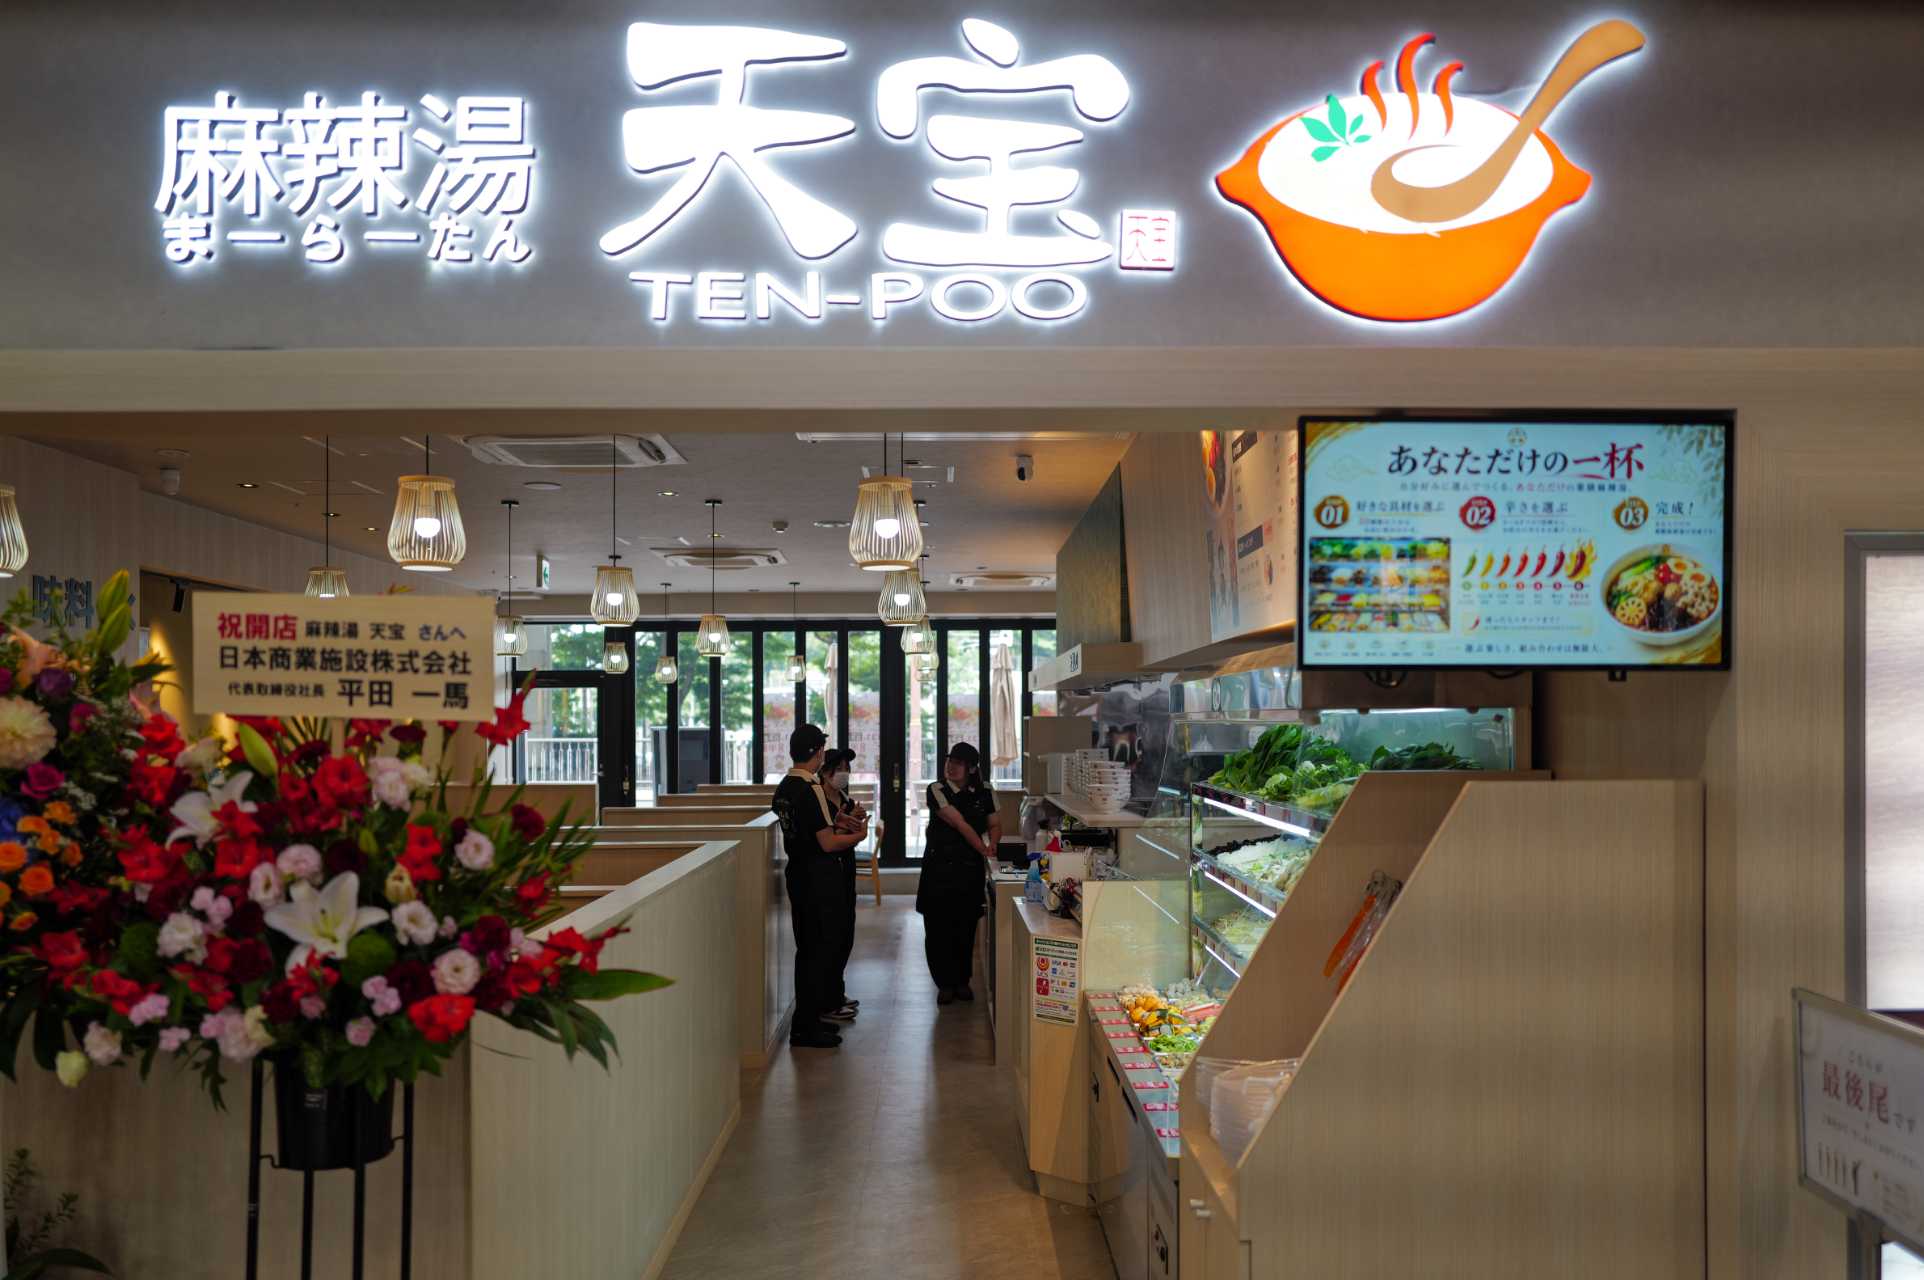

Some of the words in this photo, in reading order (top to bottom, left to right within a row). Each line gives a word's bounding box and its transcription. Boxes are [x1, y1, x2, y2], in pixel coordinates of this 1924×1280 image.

[154, 90, 536, 217] 麻辣湯
[599, 17, 1130, 268] 天宝
[161, 212, 534, 265] まーらーたん
[629, 271, 1088, 322] TEN-POO
[1387, 442, 1645, 480] あなただけの一杯
[1320, 505, 1345, 526] 01
[1466, 506, 1491, 526] 02
[1619, 508, 1646, 528] 03
[217, 612, 298, 640] 祝開店
[305, 620, 358, 639] 麻辣湯
[369, 622, 405, 641] 天宝
[418, 624, 467, 641] さんへ
[219, 645, 472, 675] 日本商業施設株式会社
[228, 682, 325, 697] 代表取締役社長
[337, 678, 393, 707] 平田
[411, 682, 469, 709] 一馬
